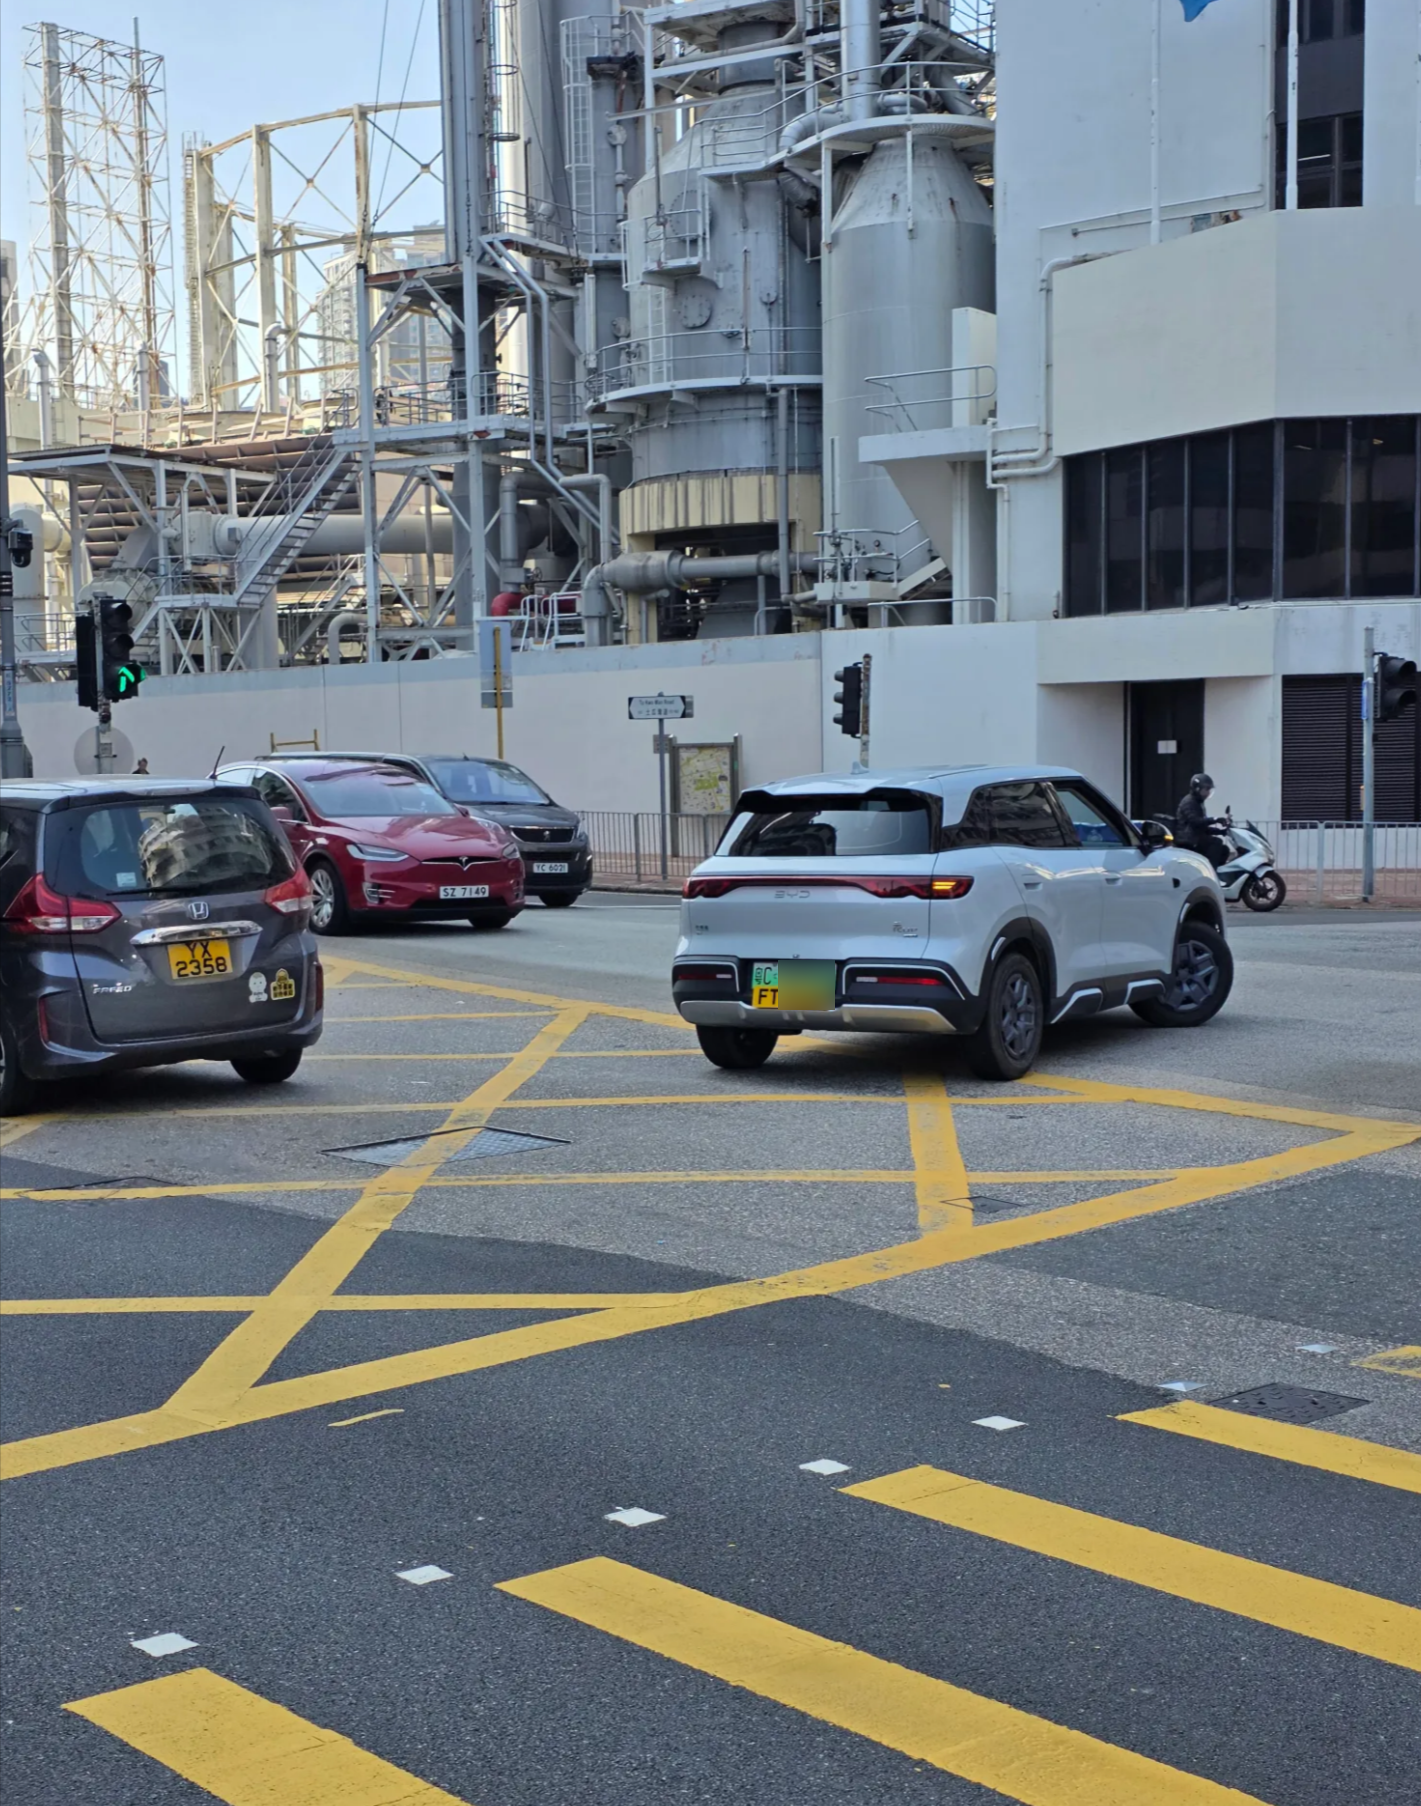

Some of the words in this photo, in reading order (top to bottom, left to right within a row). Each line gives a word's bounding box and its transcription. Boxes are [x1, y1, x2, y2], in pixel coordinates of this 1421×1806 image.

[443, 887, 457, 898] SZ
[461, 886, 487, 897] 7149
[185, 941, 212, 959] YX
[175, 956, 228, 978] 2358
[757, 988, 779, 1006] FT
